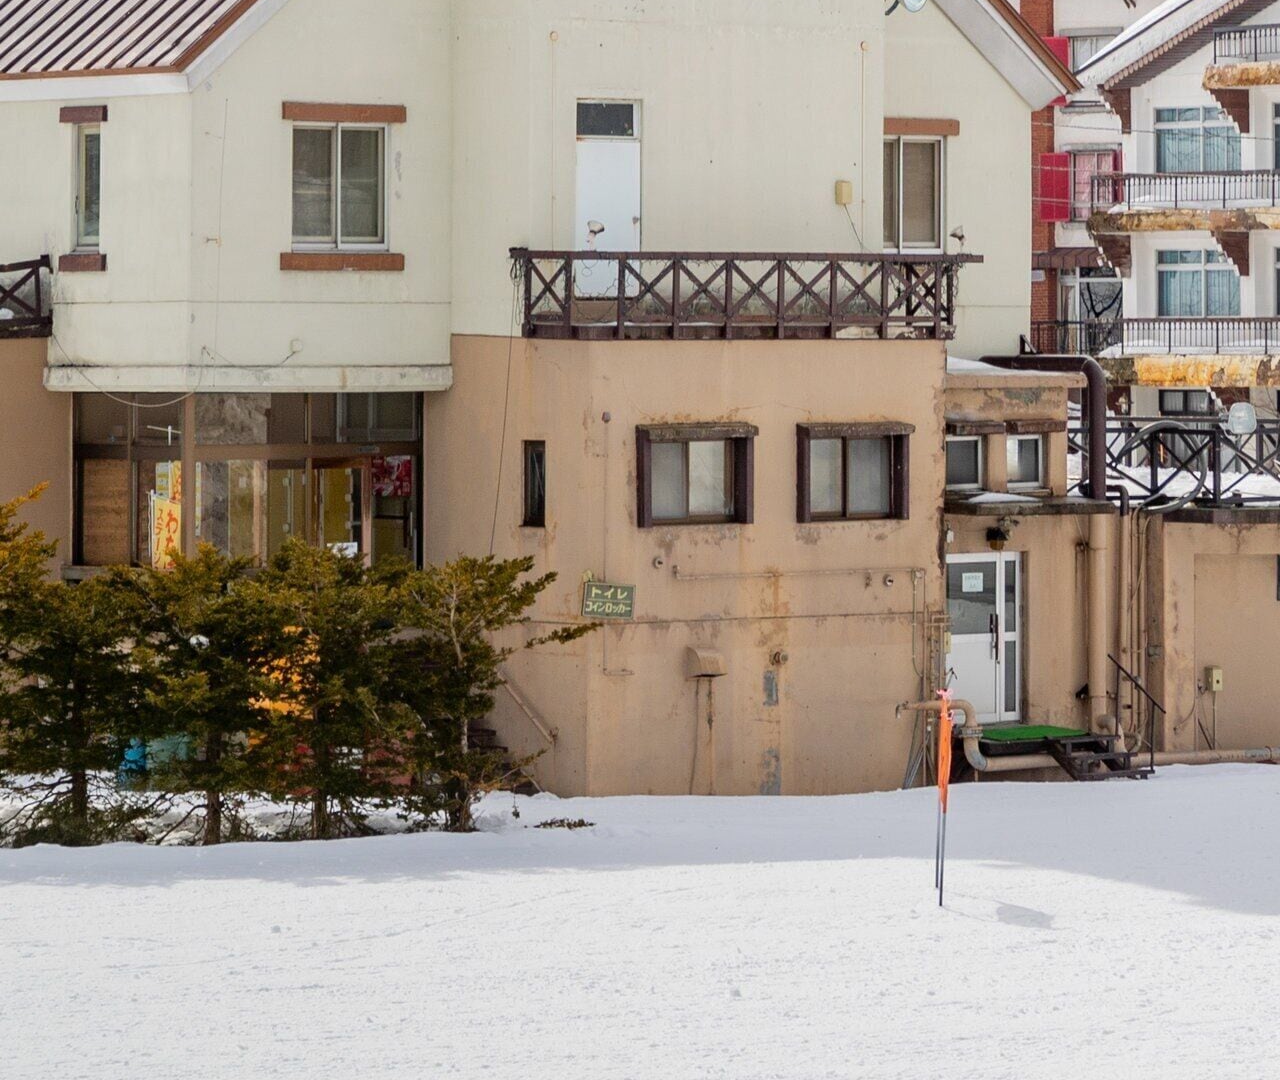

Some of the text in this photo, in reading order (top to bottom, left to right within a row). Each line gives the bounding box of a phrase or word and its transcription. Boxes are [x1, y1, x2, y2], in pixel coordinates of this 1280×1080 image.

[591, 586, 628, 599] トイレ
[585, 601, 631, 614] コインロッカー
